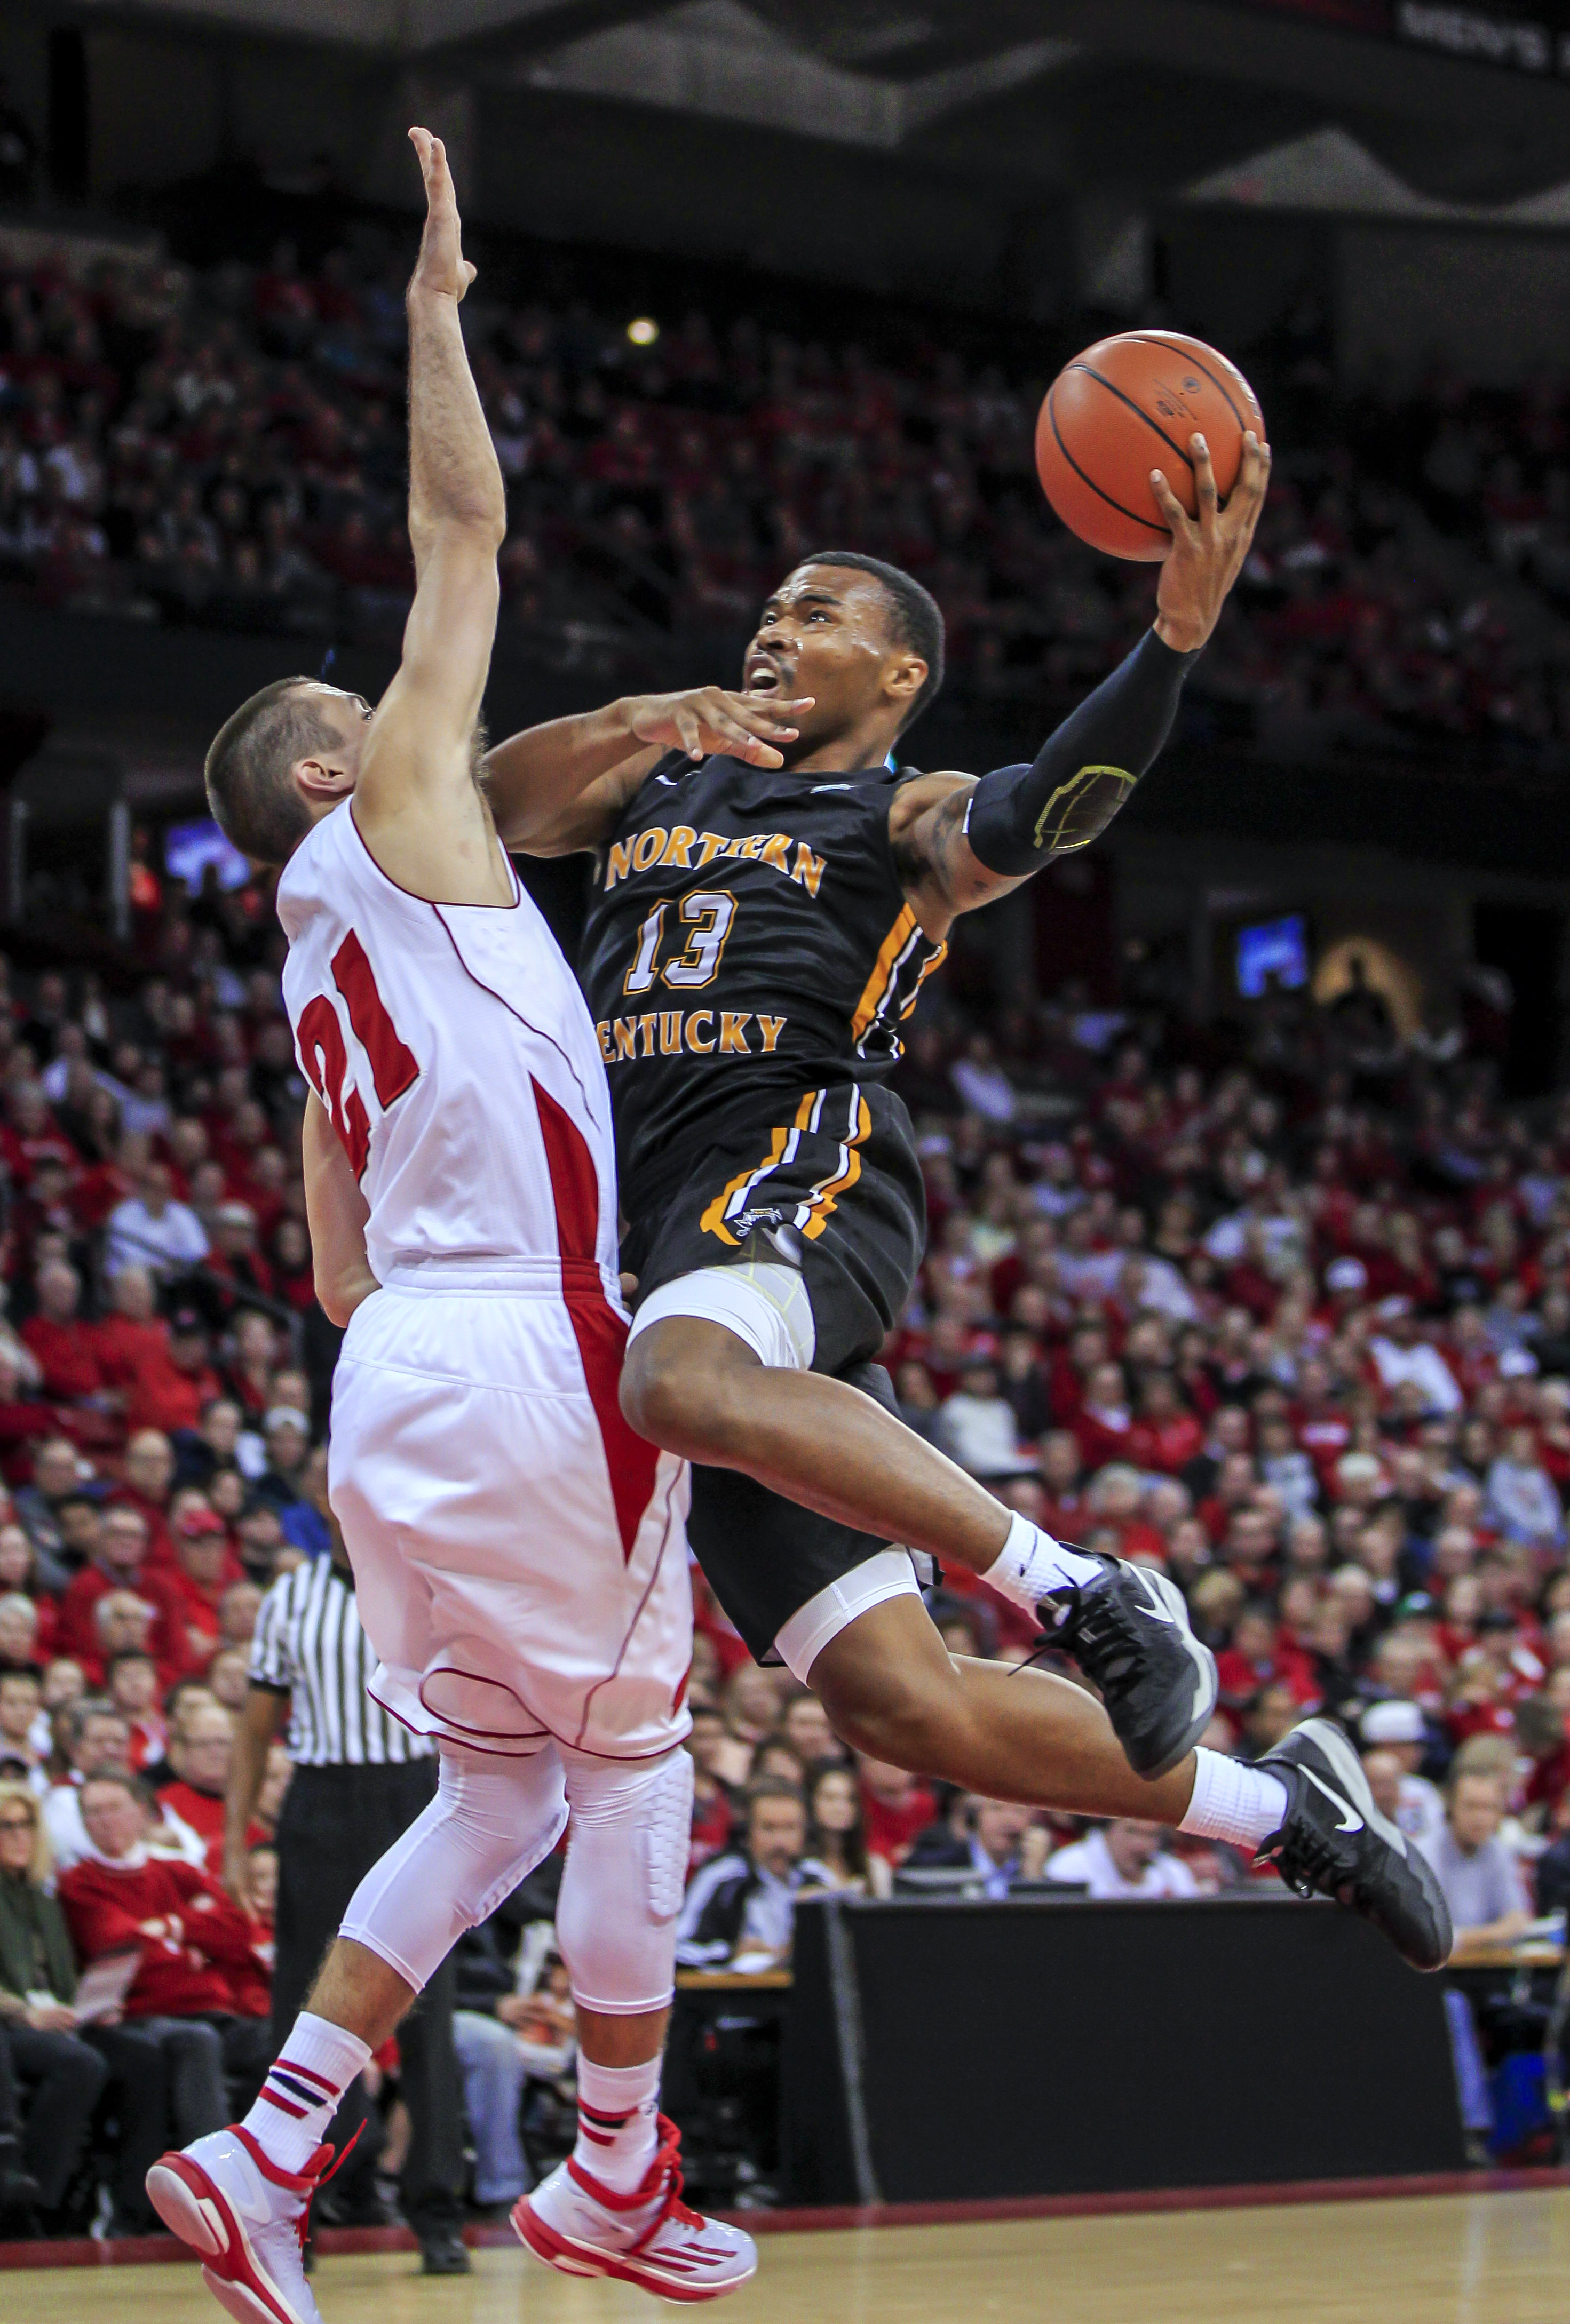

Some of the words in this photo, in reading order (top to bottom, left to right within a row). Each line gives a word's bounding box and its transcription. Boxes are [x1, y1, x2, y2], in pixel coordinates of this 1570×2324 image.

[623, 890, 739, 996] 13
[296, 926, 422, 1189] 21
[595, 1010, 787, 1063] ENTUCKY
